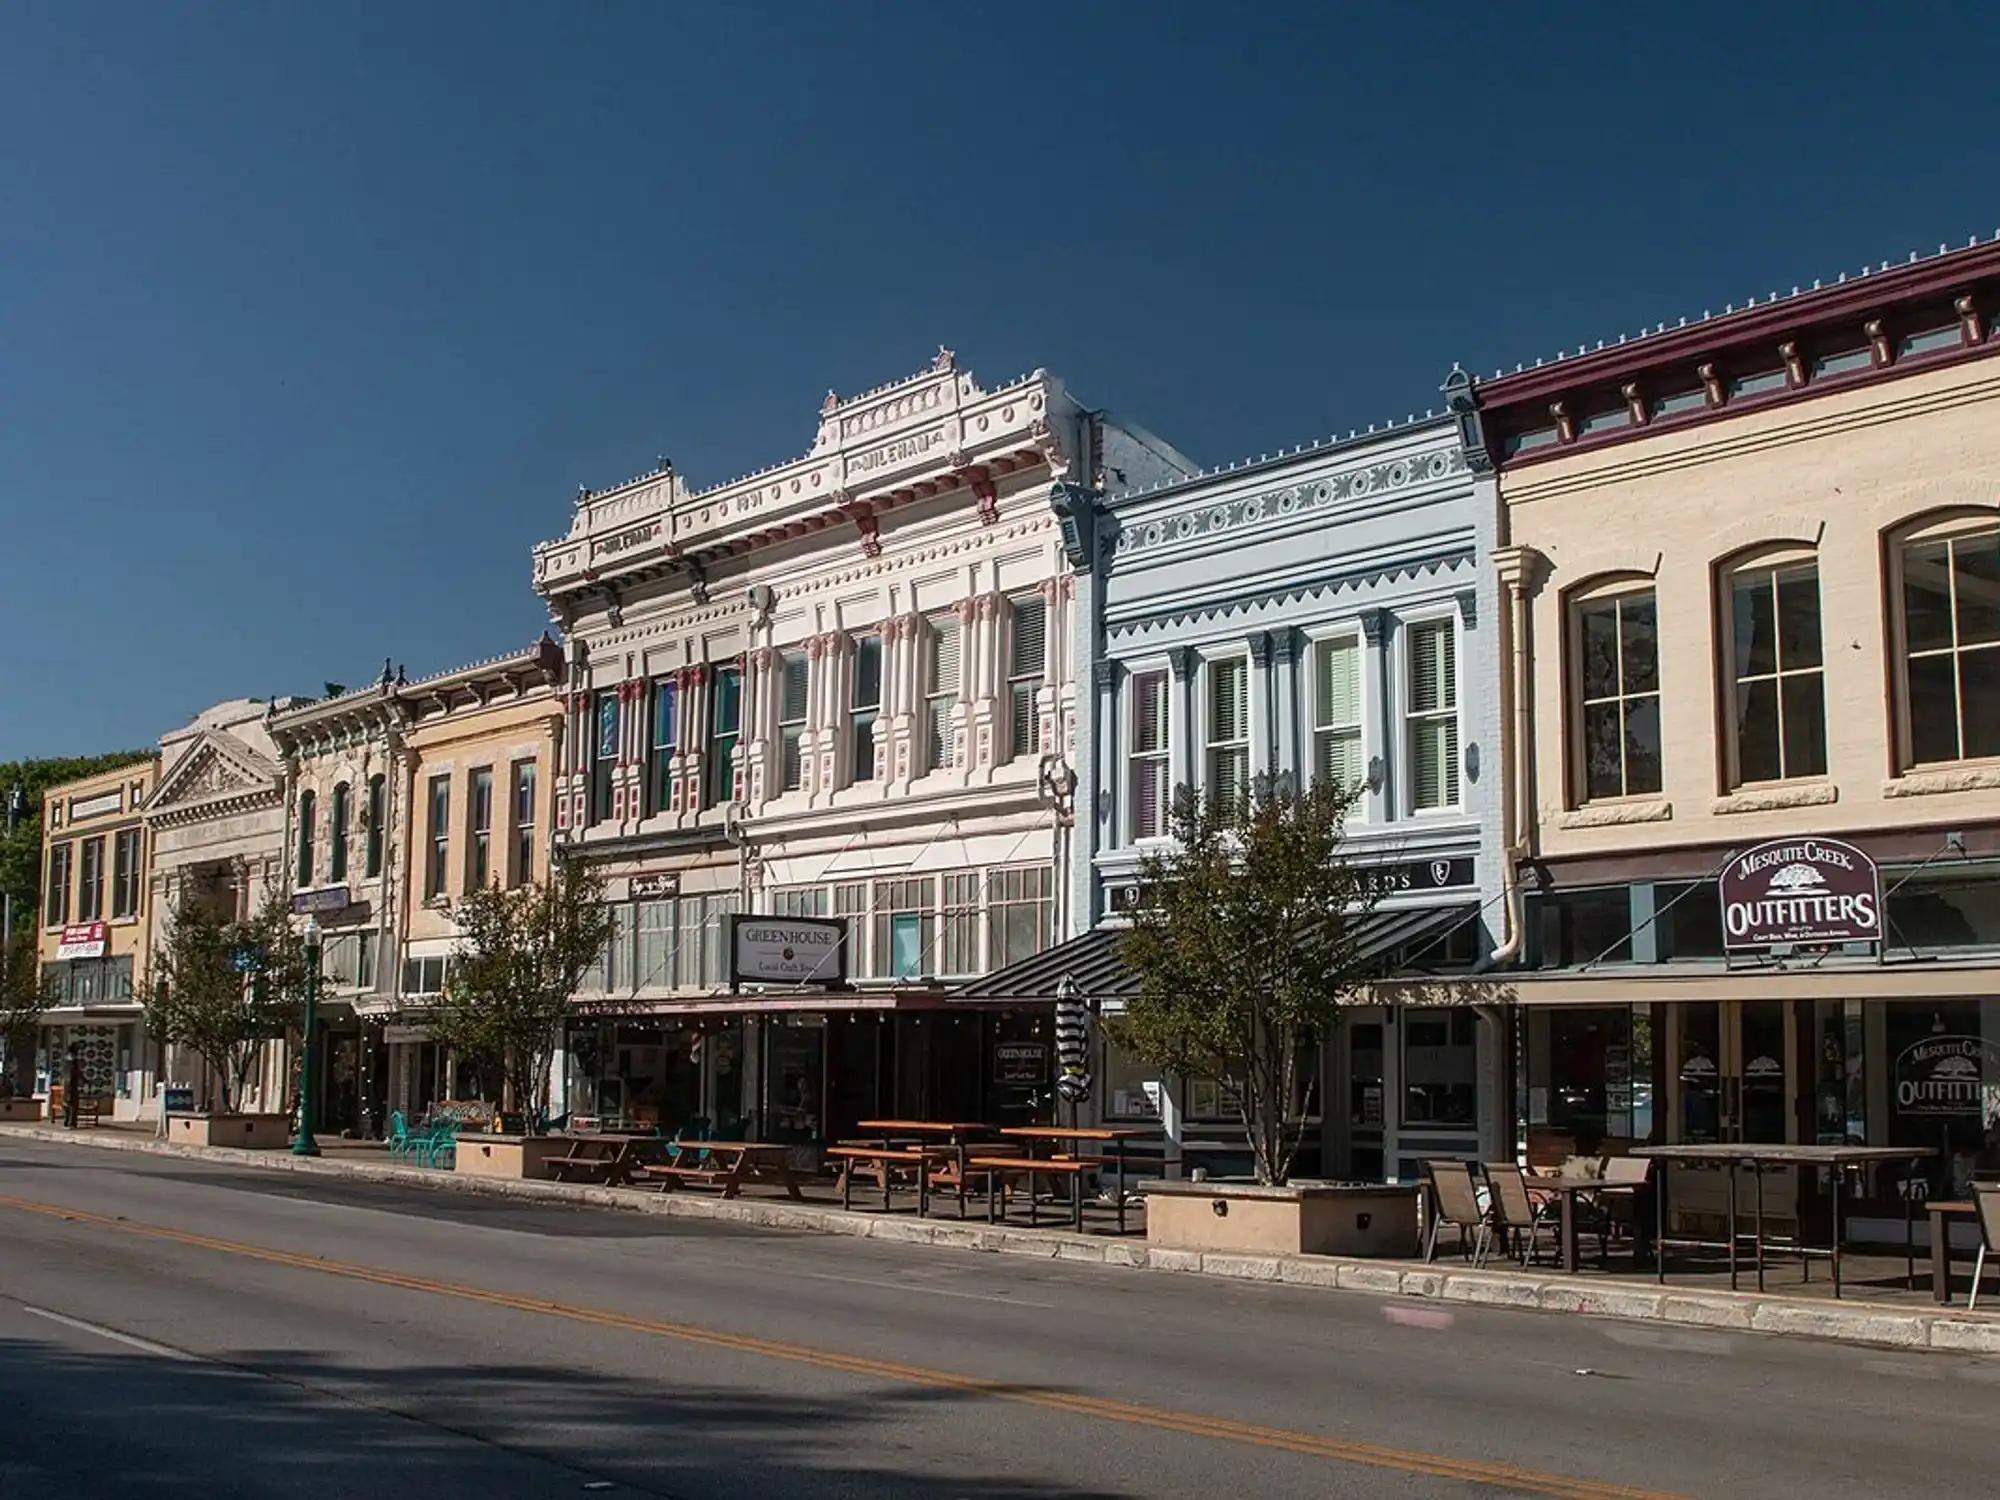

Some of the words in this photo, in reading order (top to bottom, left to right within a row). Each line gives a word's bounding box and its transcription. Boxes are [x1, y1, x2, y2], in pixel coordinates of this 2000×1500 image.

[737, 491, 762, 513] 1891
[1737, 846, 1805, 880] MESQUITE
[1805, 841, 1854, 871] CREEK
[1727, 893, 1876, 936] OUTFITTERS
[746, 928, 832, 946] GREENHOUSE
